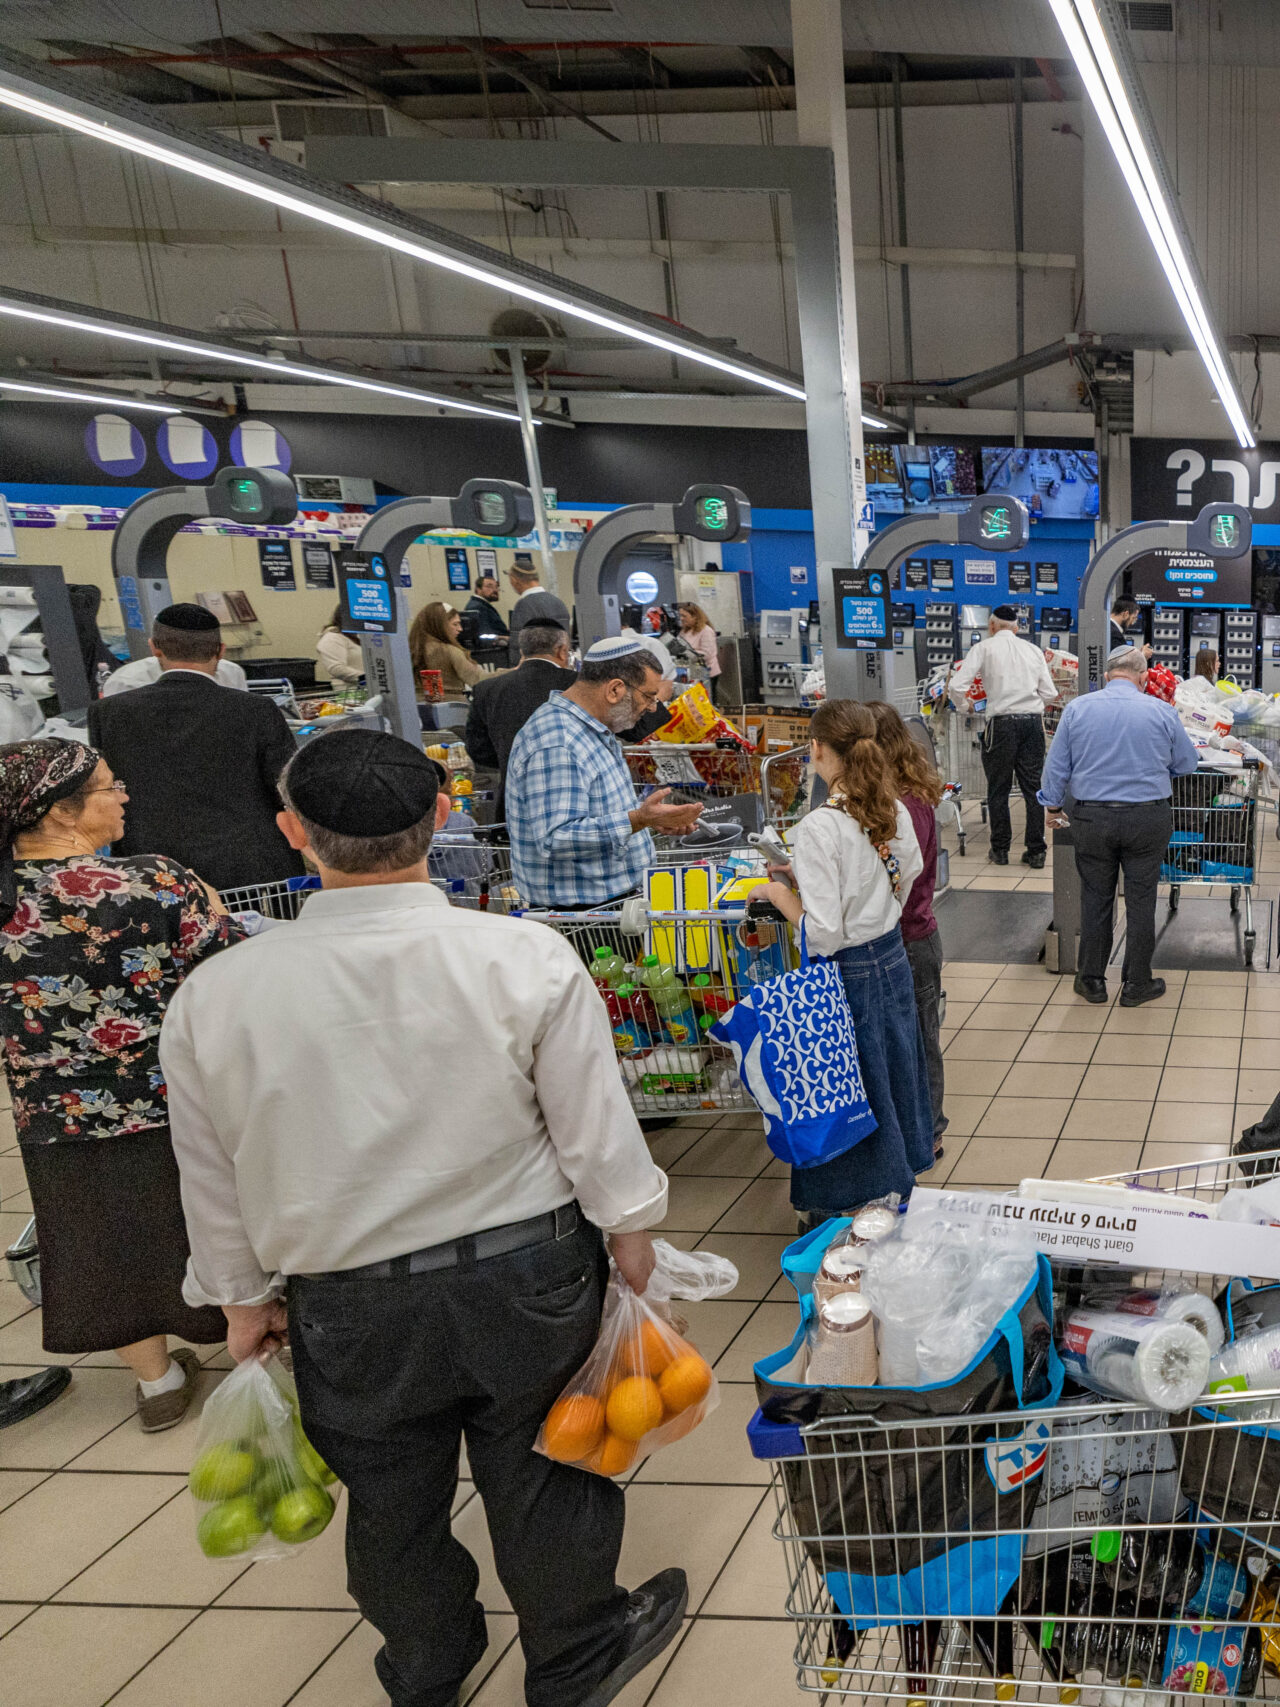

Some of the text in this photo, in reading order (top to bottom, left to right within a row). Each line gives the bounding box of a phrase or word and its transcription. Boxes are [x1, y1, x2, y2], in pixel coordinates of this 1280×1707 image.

[704, 498, 727, 529] 3
[982, 507, 1010, 538] 4
[1168, 558, 1215, 568] העצמאית
[868, 573, 883, 594] 6
[361, 590, 379, 598] 500
[856, 607, 873, 615] 500
[1086, 645, 1098, 682] smart
[1029, 1207, 1076, 1226] ענקית
[1080, 1213, 1091, 1229] 6
[1095, 1218, 1137, 1232] סירים
[1061, 1233, 1101, 1250] Shabat
[1101, 1235, 1135, 1253] Giant
